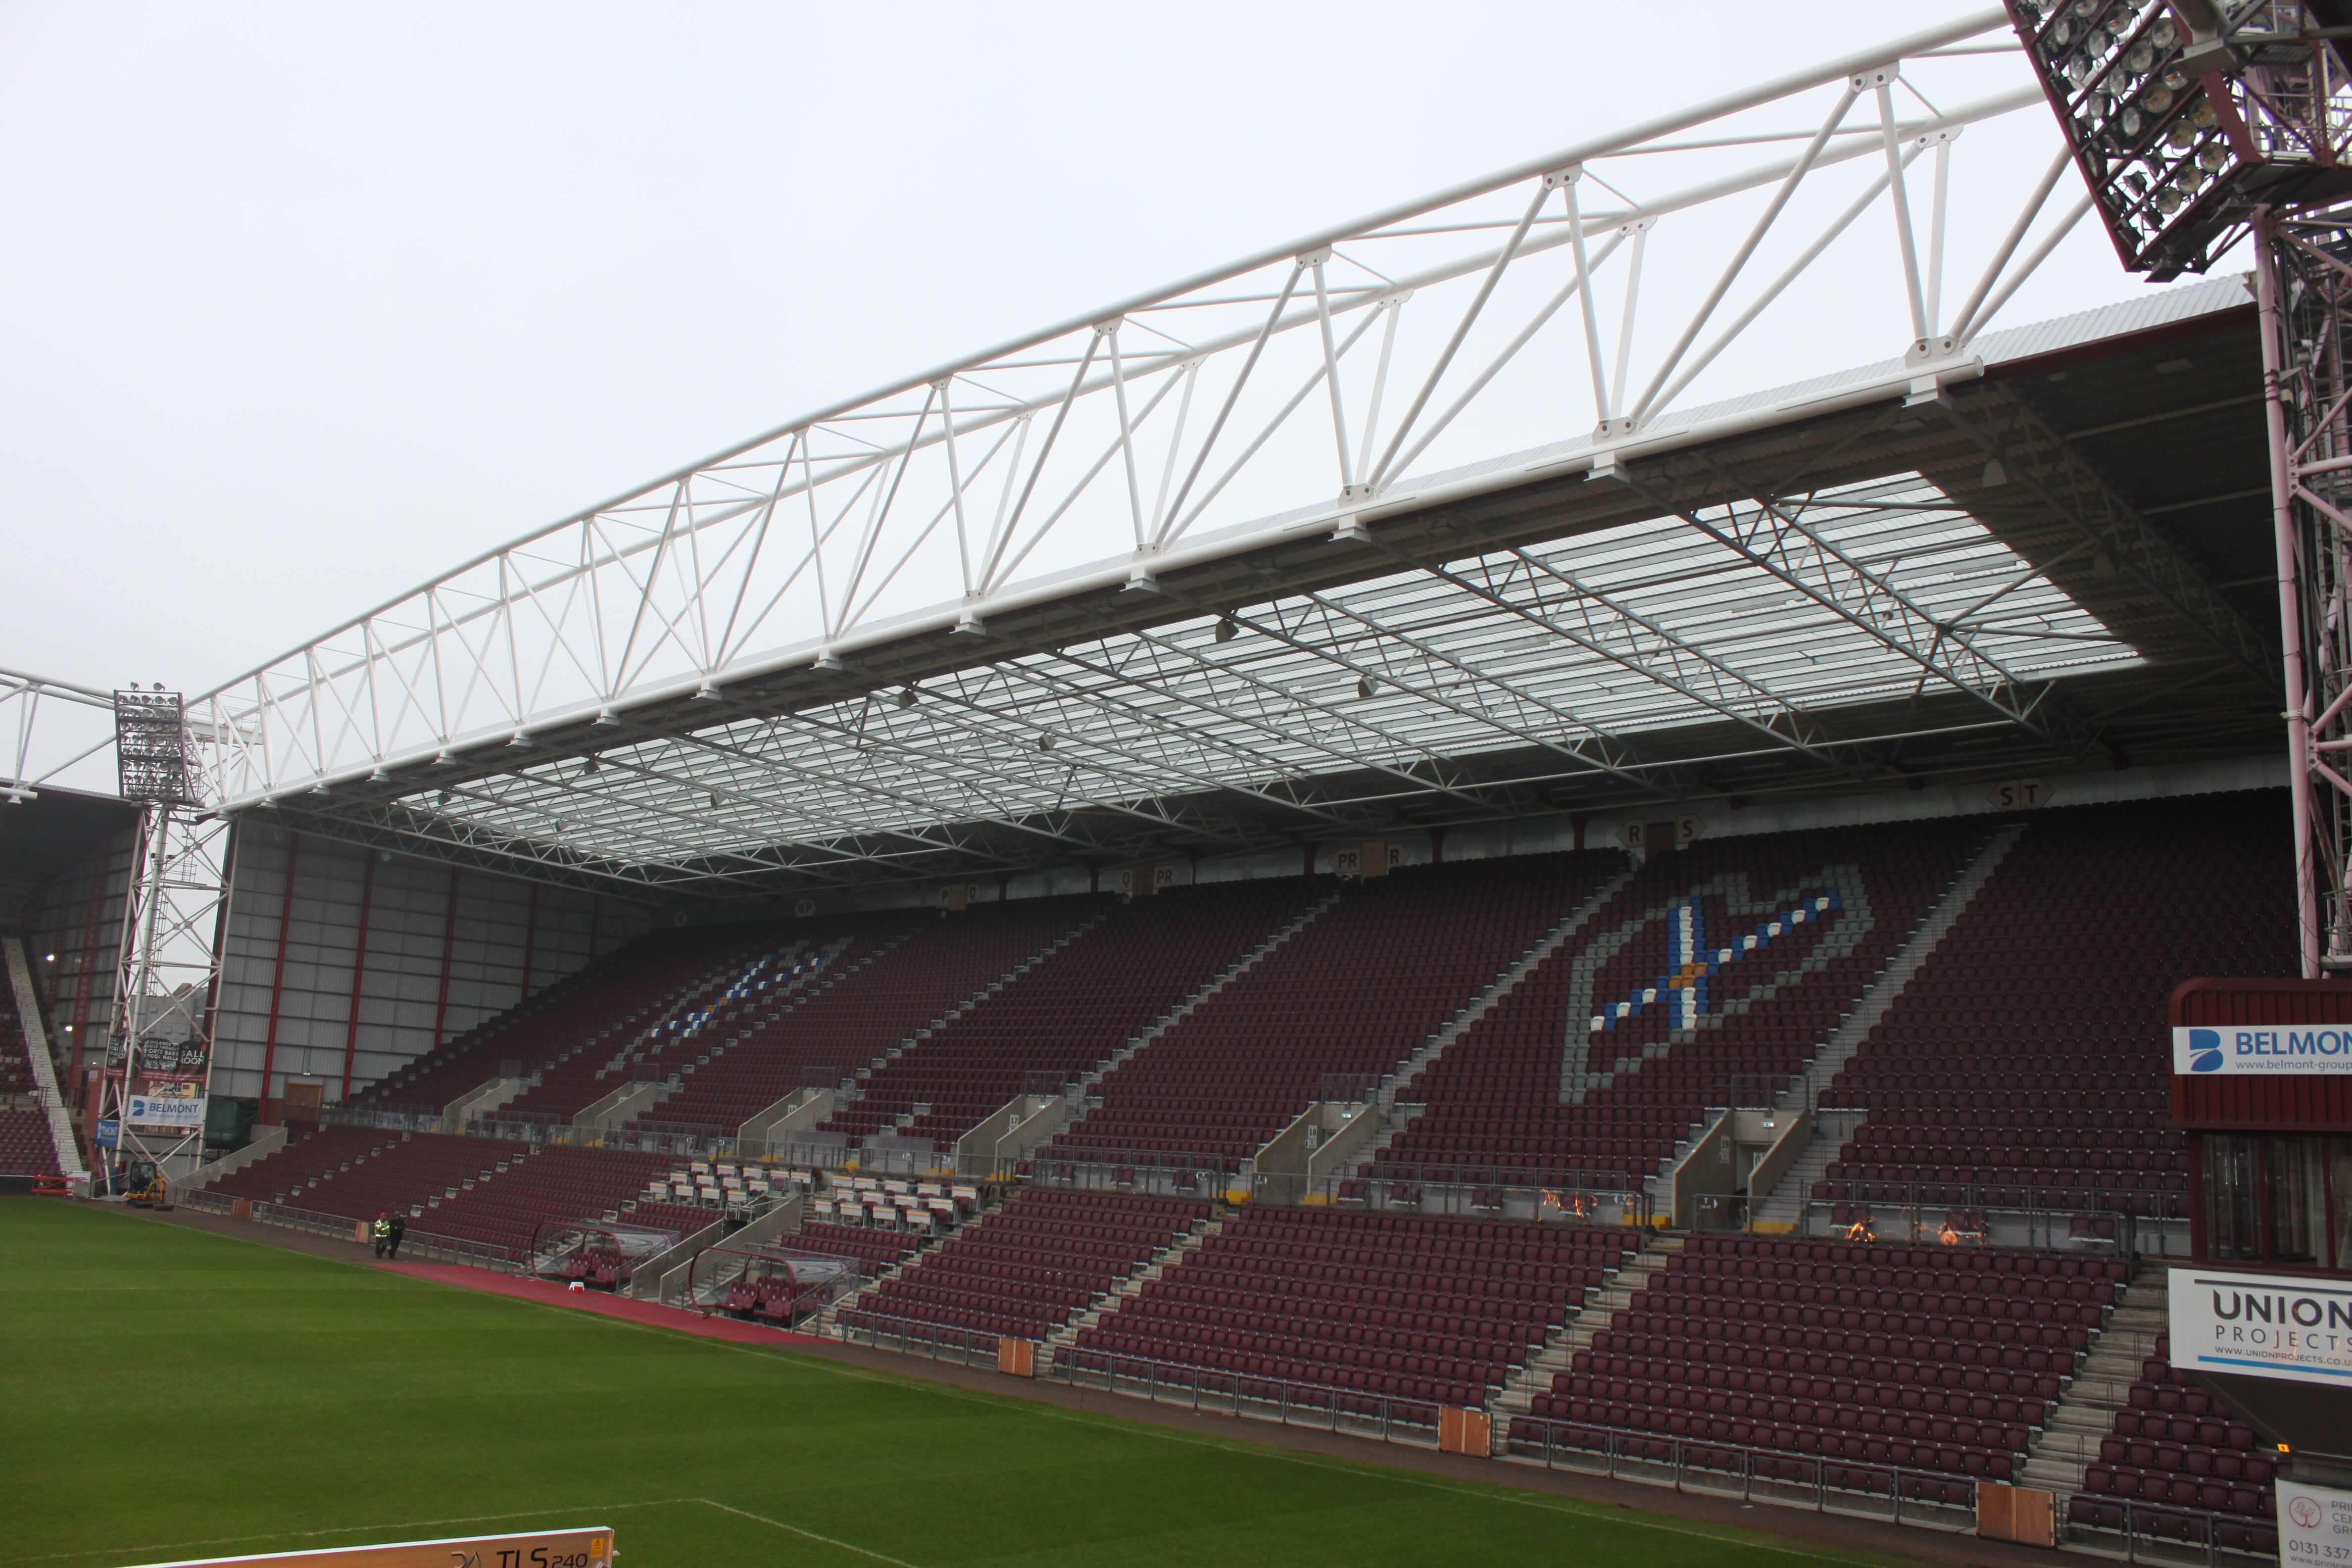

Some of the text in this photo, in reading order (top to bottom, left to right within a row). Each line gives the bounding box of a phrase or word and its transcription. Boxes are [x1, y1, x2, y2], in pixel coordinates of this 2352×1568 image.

[2001, 784, 2038, 806] S T
[1629, 825, 1640, 842] R
[1682, 820, 1693, 837] S
[1338, 853, 1357, 868] PR
[1390, 849, 1399, 864] R
[1157, 870, 1173, 884] PR
[149, 1103, 198, 1113] BELMONT
[2213, 1289, 2352, 1330] UNION
[2215, 1346, 2352, 1367] WWW.UNIONPROJECTS.CO.U
[2332, 1501, 2352, 1511] PRI
[2333, 1524, 2352, 1535] GR
[2289, 1540, 2350, 1560] 0131 337
[552, 1553, 588, 1568] 240
